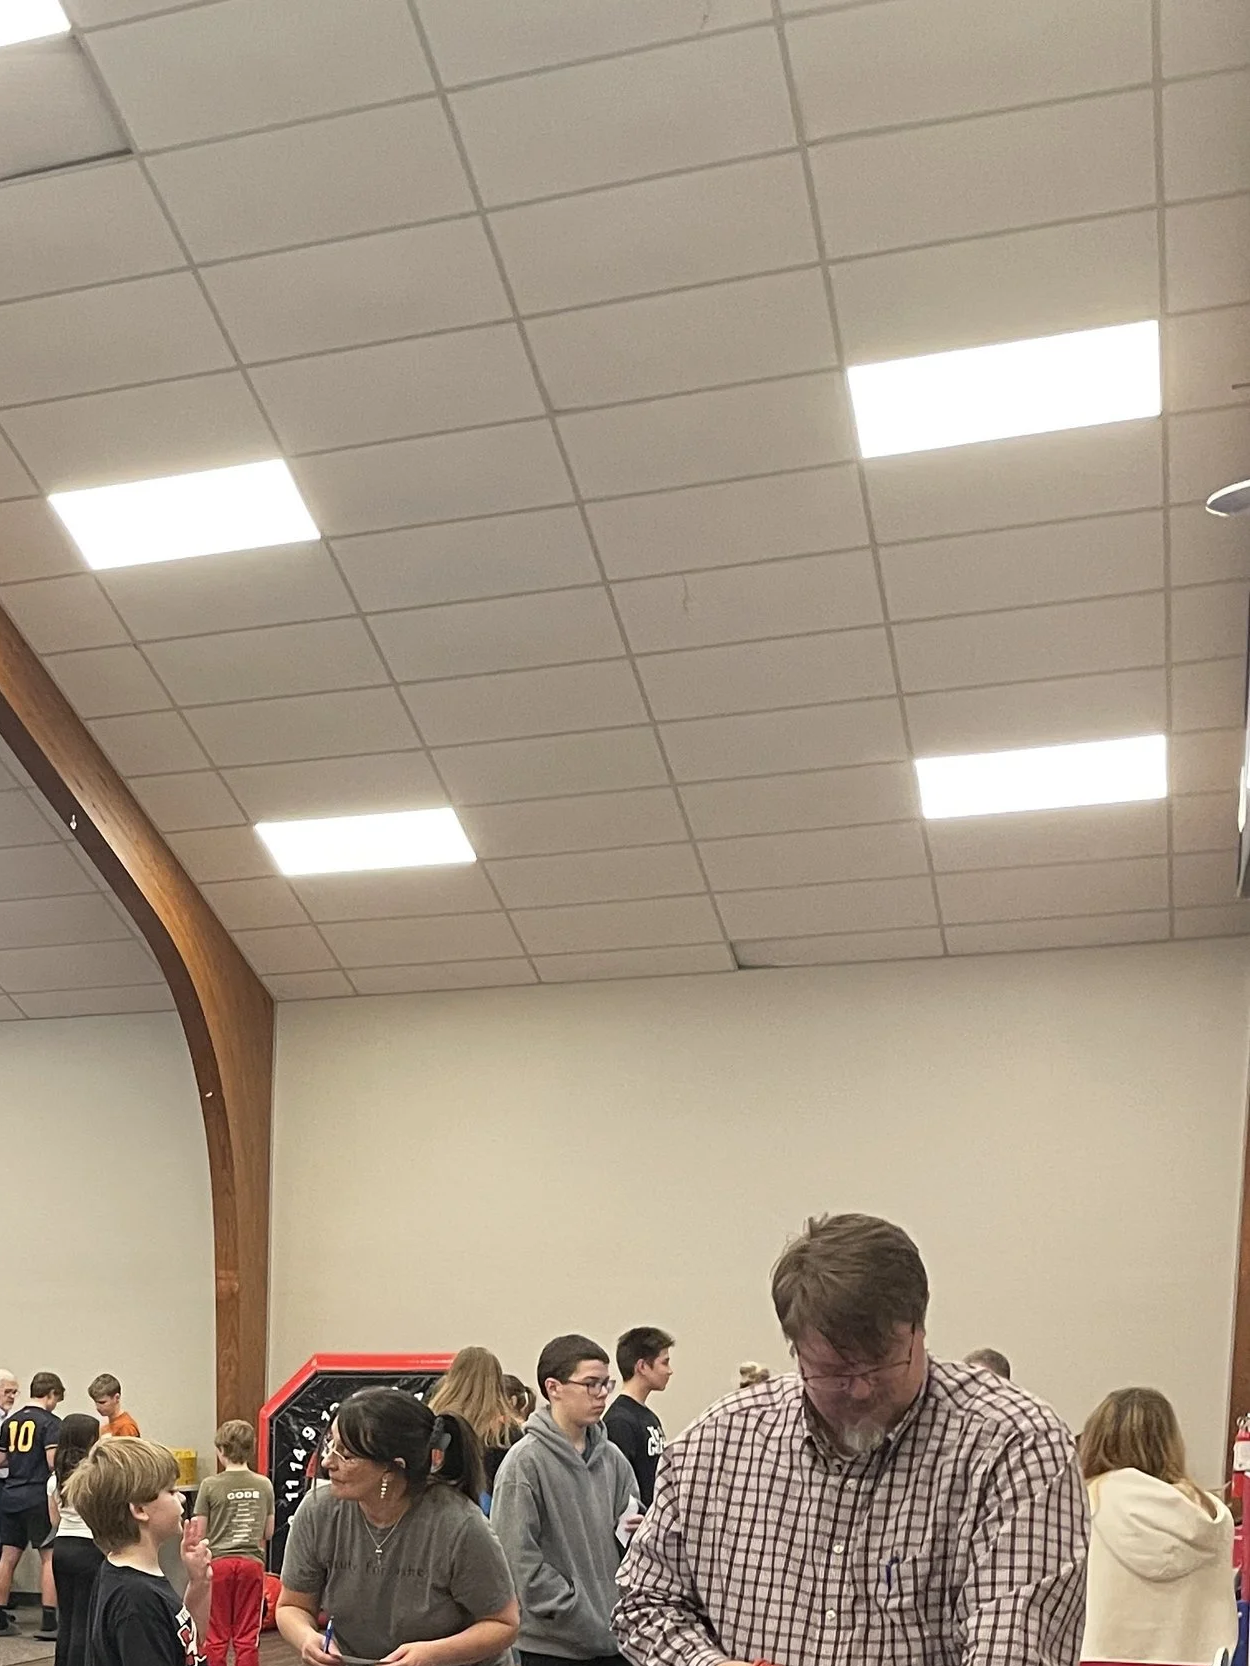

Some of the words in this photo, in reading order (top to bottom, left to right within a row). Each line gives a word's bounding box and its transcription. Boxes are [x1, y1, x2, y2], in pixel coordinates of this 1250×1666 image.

[8, 1420, 36, 1452] 10
[301, 1426, 316, 1440] 9
[290, 1448, 307, 1472] 14
[285, 1480, 299, 1501] 11
